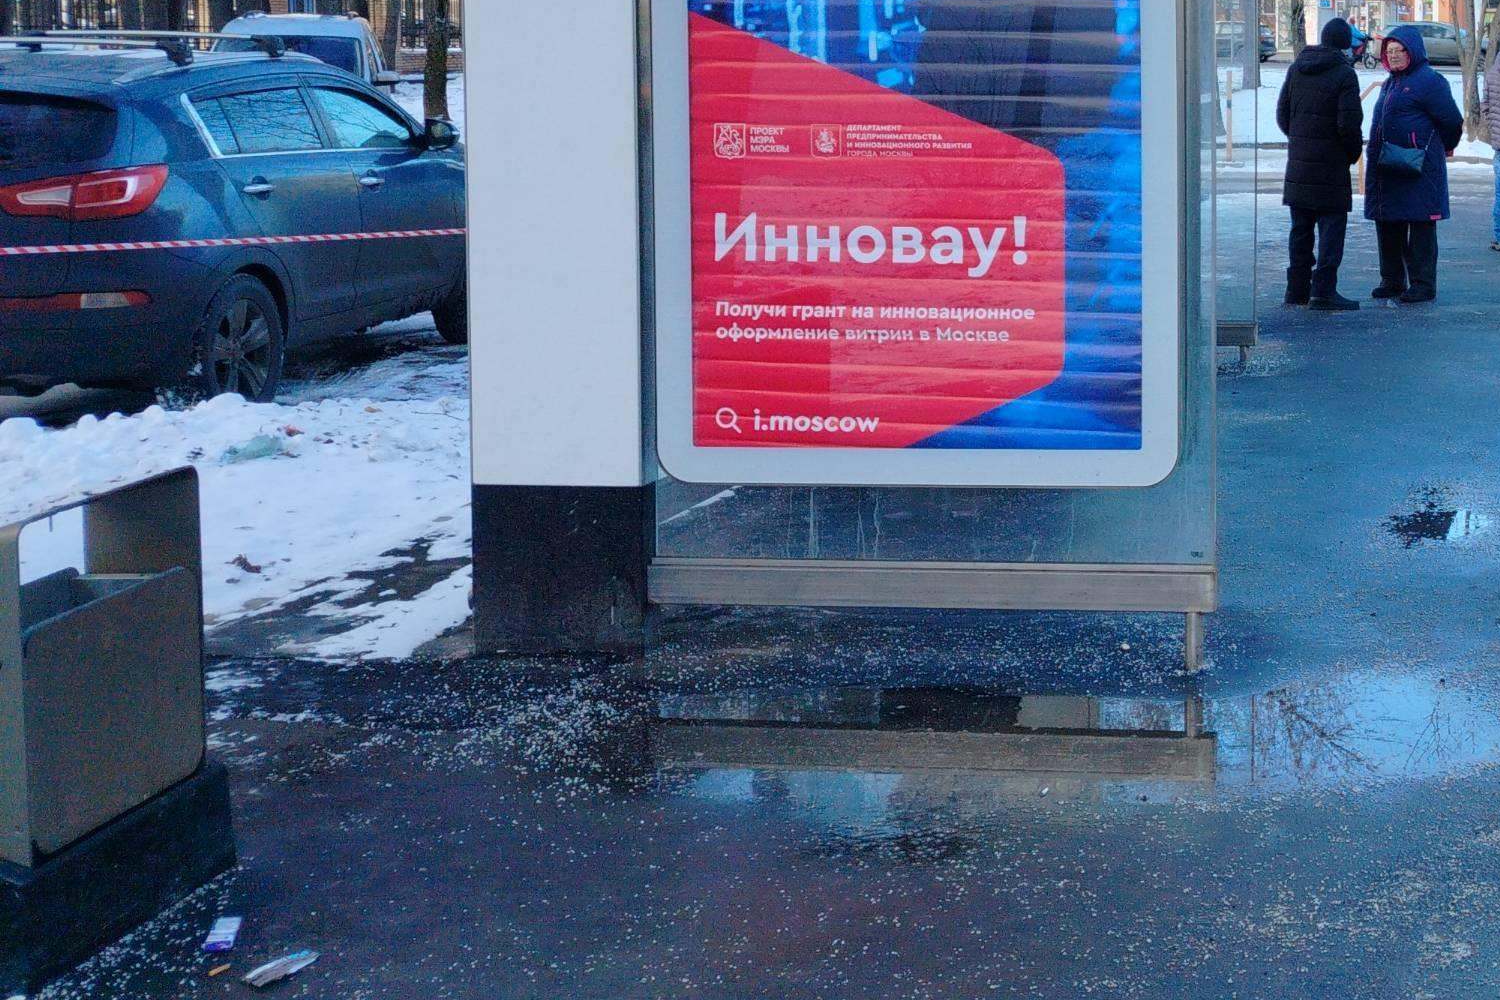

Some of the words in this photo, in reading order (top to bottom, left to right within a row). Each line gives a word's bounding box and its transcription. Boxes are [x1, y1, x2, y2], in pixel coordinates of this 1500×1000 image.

[749, 126, 785, 136] ПРОЕКТ
[846, 124, 902, 132] ДЕПАРТАМЕНТ
[749, 135, 776, 144] МЭРА
[750, 144, 790, 153] МОСКВЫ
[854, 142, 930, 150] ИННОВАЦИОННОГО
[714, 212, 1027, 278] Инновау!
[715, 301, 786, 320] Получи
[792, 305, 846, 320] грант
[851, 305, 874, 319] на
[880, 306, 1035, 322] инновационное
[716, 323, 839, 342] оформление
[845, 328, 914, 343] витрин
[920, 329, 930, 341] в
[936, 327, 1009, 342] Москве
[753, 408, 880, 433] i.moscow
